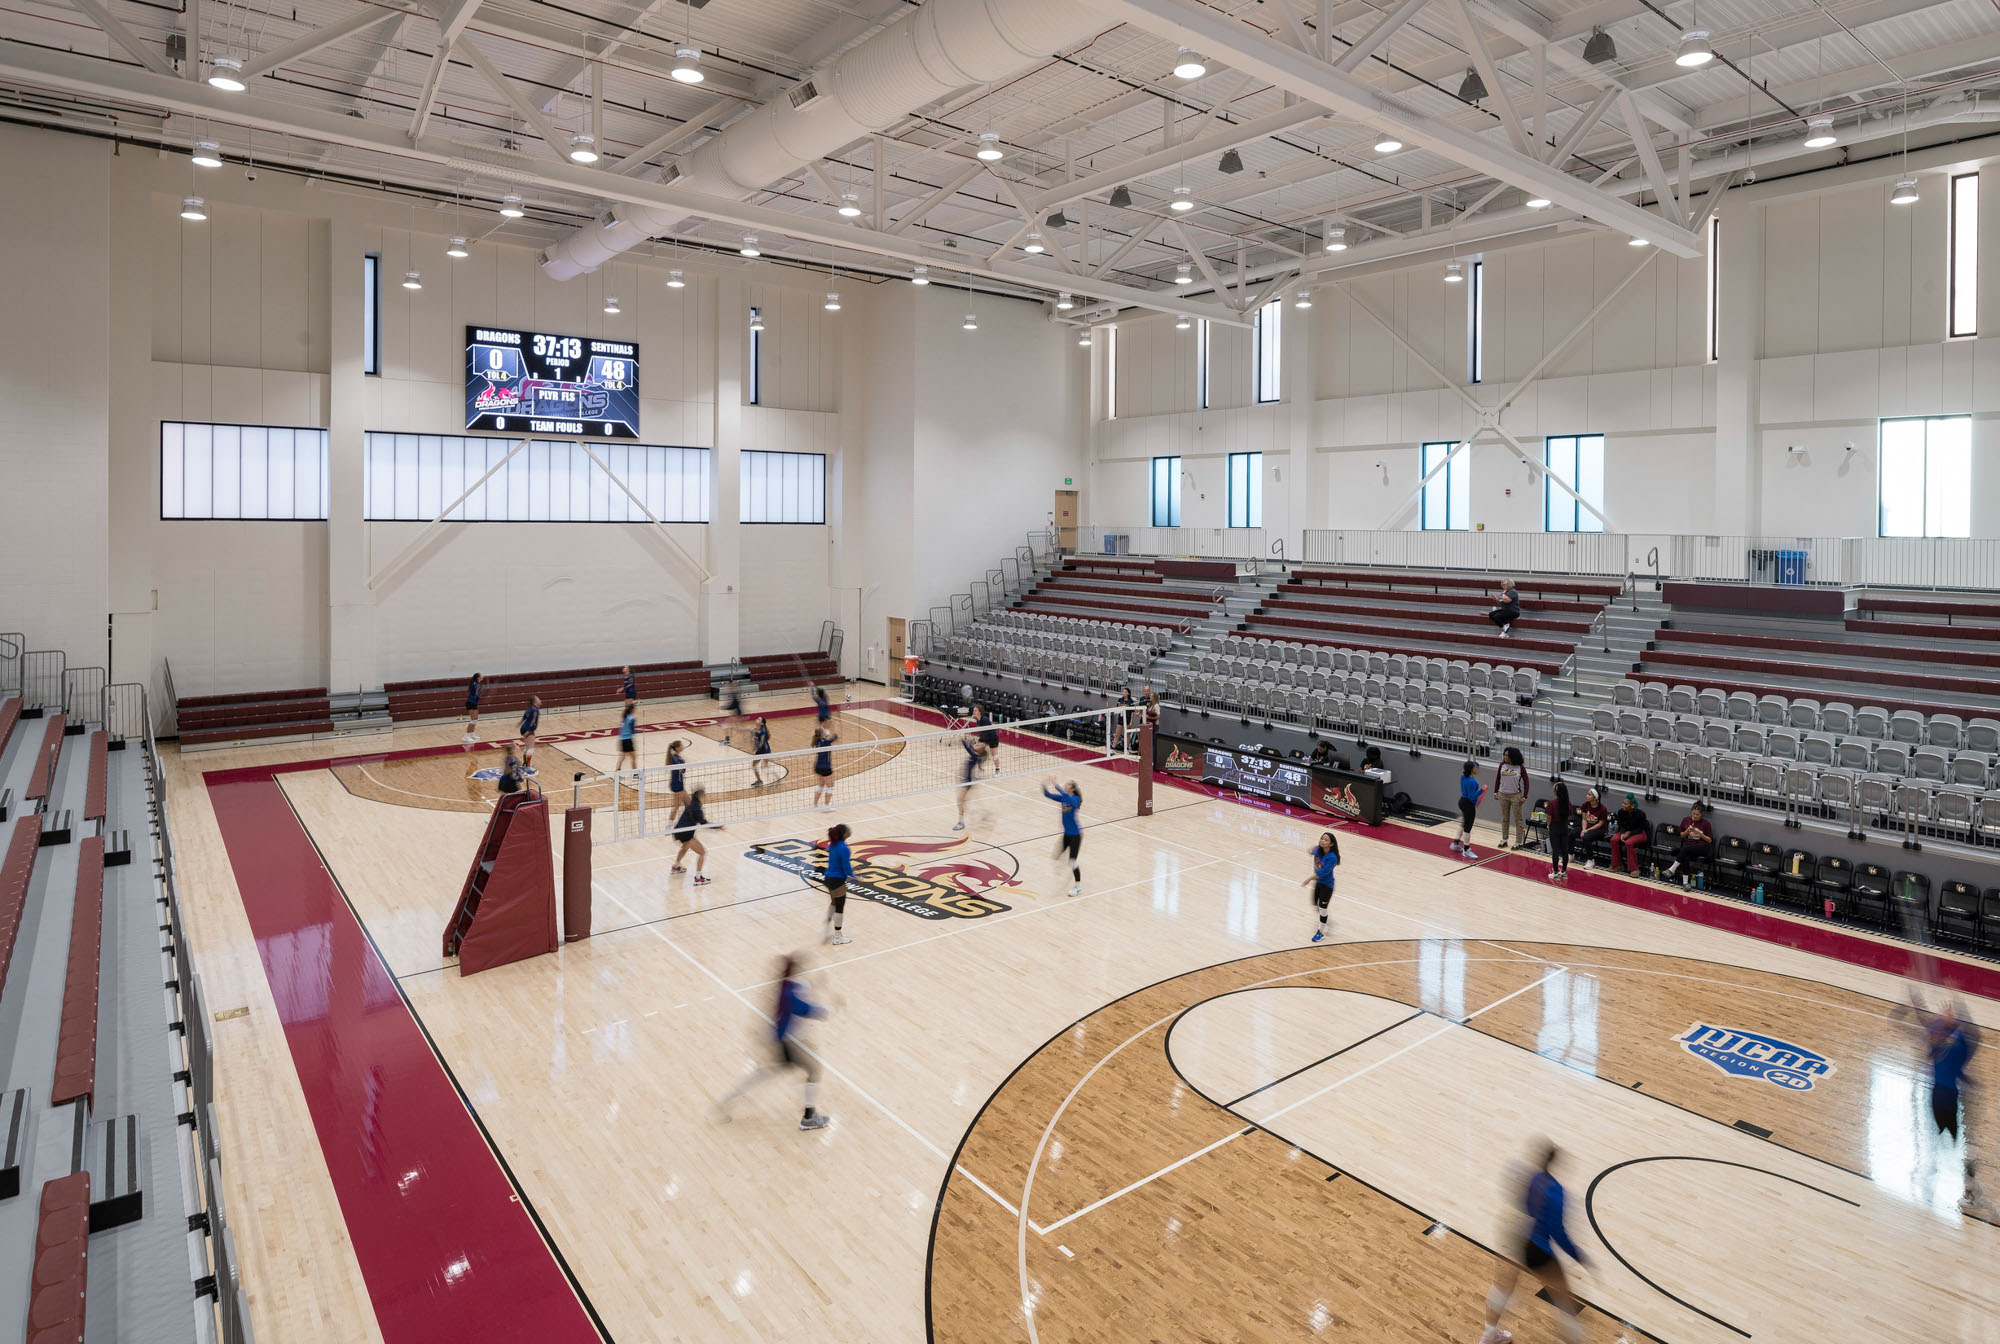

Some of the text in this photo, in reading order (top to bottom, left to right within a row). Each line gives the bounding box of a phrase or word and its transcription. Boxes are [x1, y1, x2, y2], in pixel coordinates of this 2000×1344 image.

[476, 330, 521, 345] DRAGONS
[533, 335, 582, 359] 37:13
[591, 342, 634, 356] SENTINALS
[489, 349, 503, 370] 0
[546, 357, 570, 367] PERIOD
[554, 367, 561, 380] 1
[601, 360, 625, 381] 48
[474, 397, 520, 409] DRAGONS
[539, 390, 576, 402] PLYR FLS
[496, 416, 505, 430] 0
[530, 420, 583, 433] TEAM FOULS
[604, 423, 612, 435] 0
[1241, 755, 1272, 769] 37:13
[1284, 771, 1302, 782] 48
[1323, 794, 1361, 816] DRAGONS
[753, 852, 805, 871] HOWARD
[873, 894, 939, 917] COLLEGE
[1698, 1047, 1760, 1072] REGION
[1772, 1071, 1809, 1089] 20
